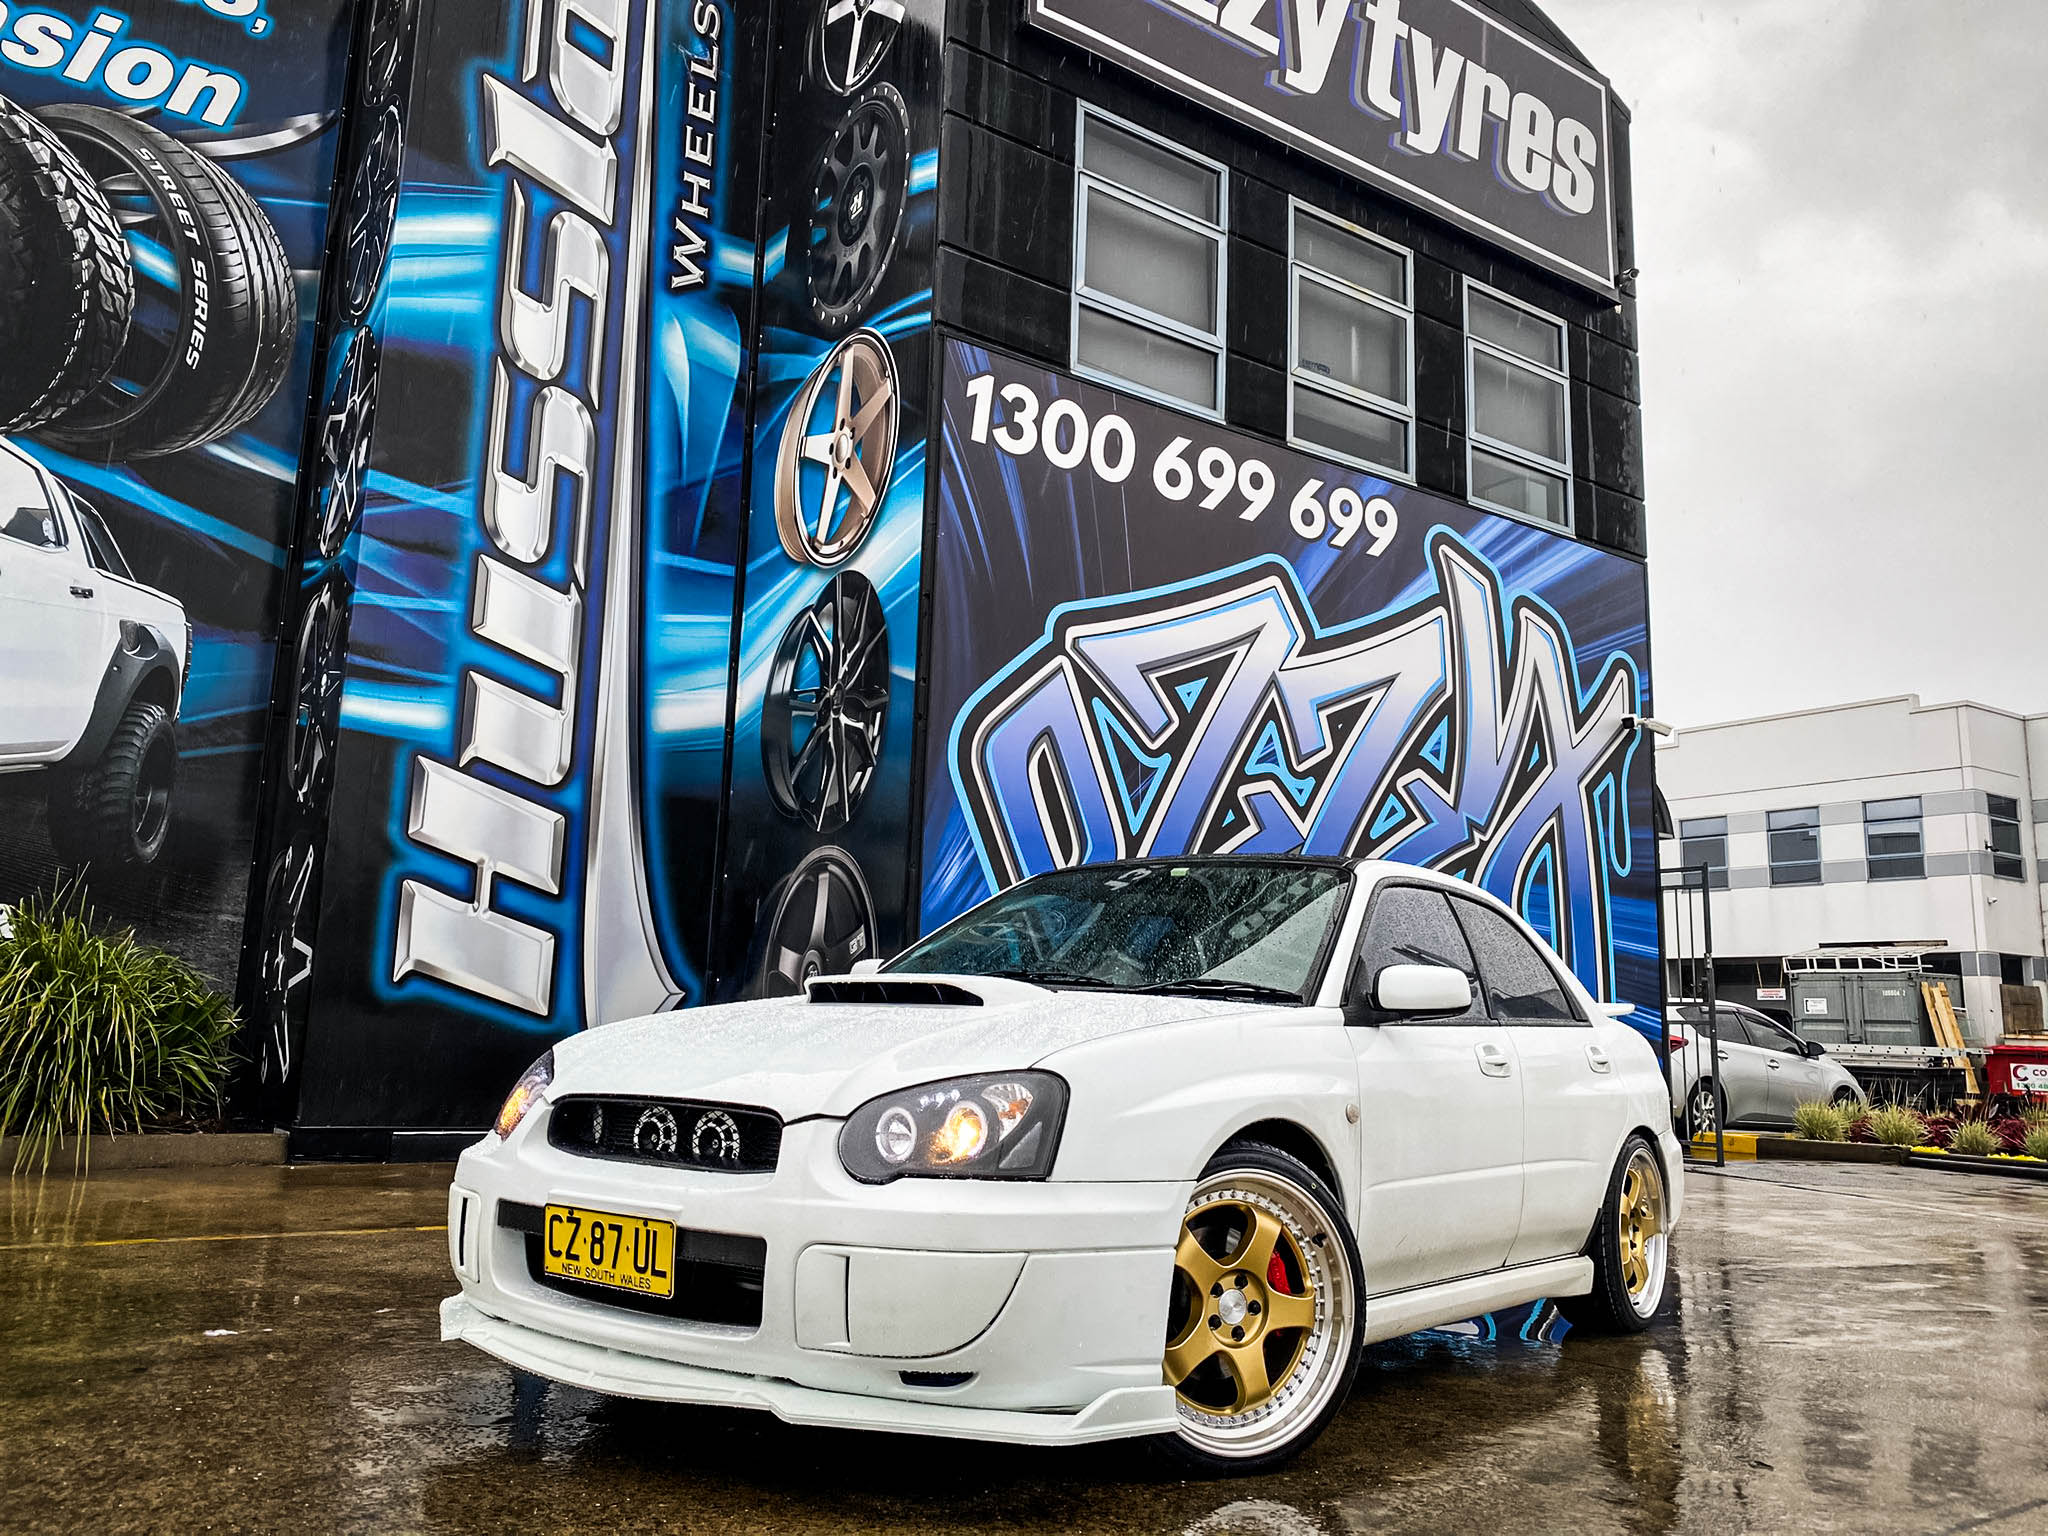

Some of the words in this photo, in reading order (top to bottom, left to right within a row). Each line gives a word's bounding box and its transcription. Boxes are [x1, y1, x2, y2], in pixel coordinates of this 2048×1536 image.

[0, 2, 242, 127] sion
[671, 0, 721, 289] WHEELS
[134, 147, 201, 246] STREET
[185, 256, 209, 370] SERIES
[964, 374, 1136, 483] 1300
[1153, 437, 1276, 522] 699
[1289, 477, 1399, 557] 699
[561, 1262, 582, 1276] NEW
[585, 1266, 616, 1283] SOUTH
[620, 1271, 652, 1290] WALES
